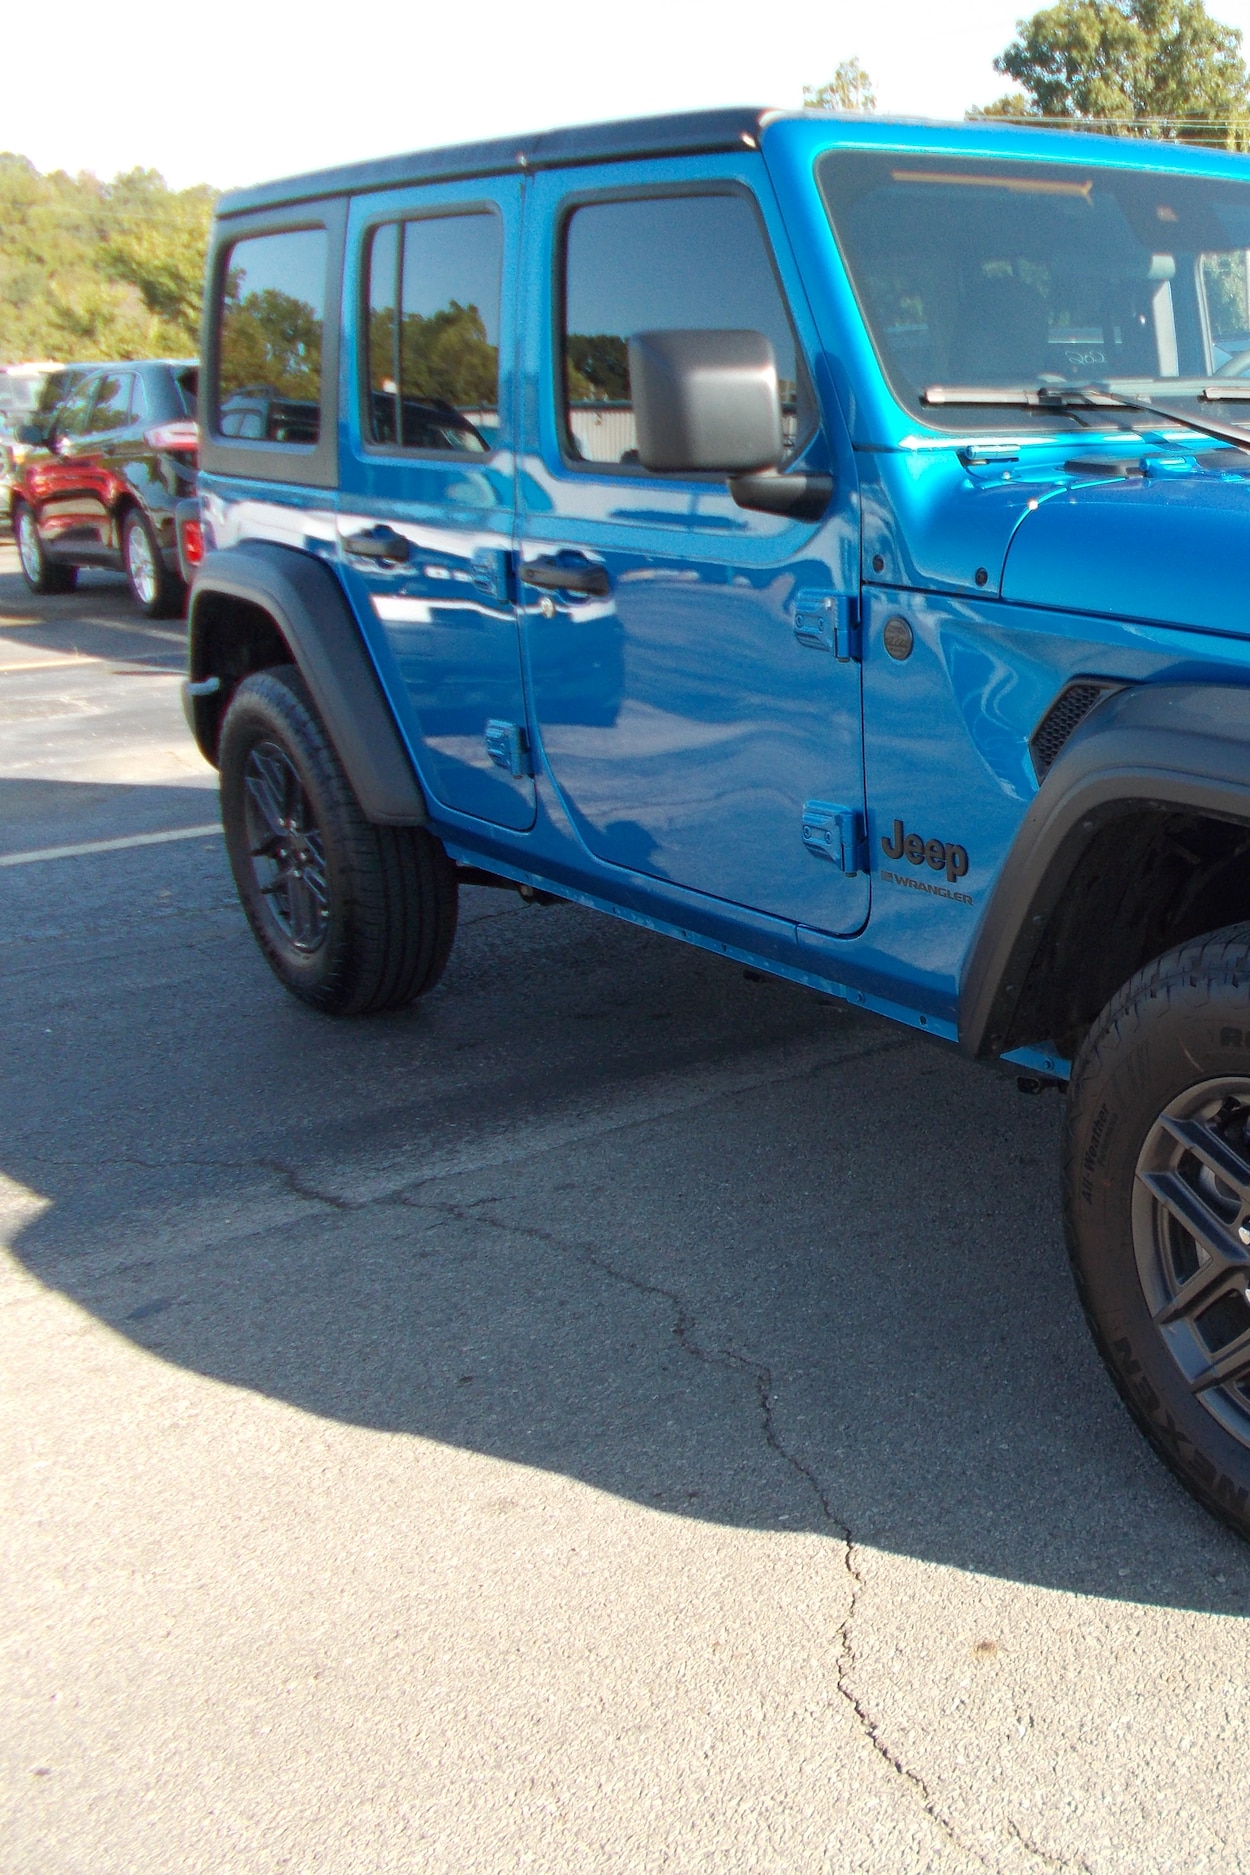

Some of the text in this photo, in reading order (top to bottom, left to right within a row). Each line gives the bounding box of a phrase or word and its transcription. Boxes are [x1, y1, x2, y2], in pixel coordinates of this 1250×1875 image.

[881, 819, 969, 883] Jeep
[893, 873, 974, 906] WRANGLER
[1081, 1101, 1110, 1206] All-Weather
[1113, 1336, 1250, 1513] NEXEN
